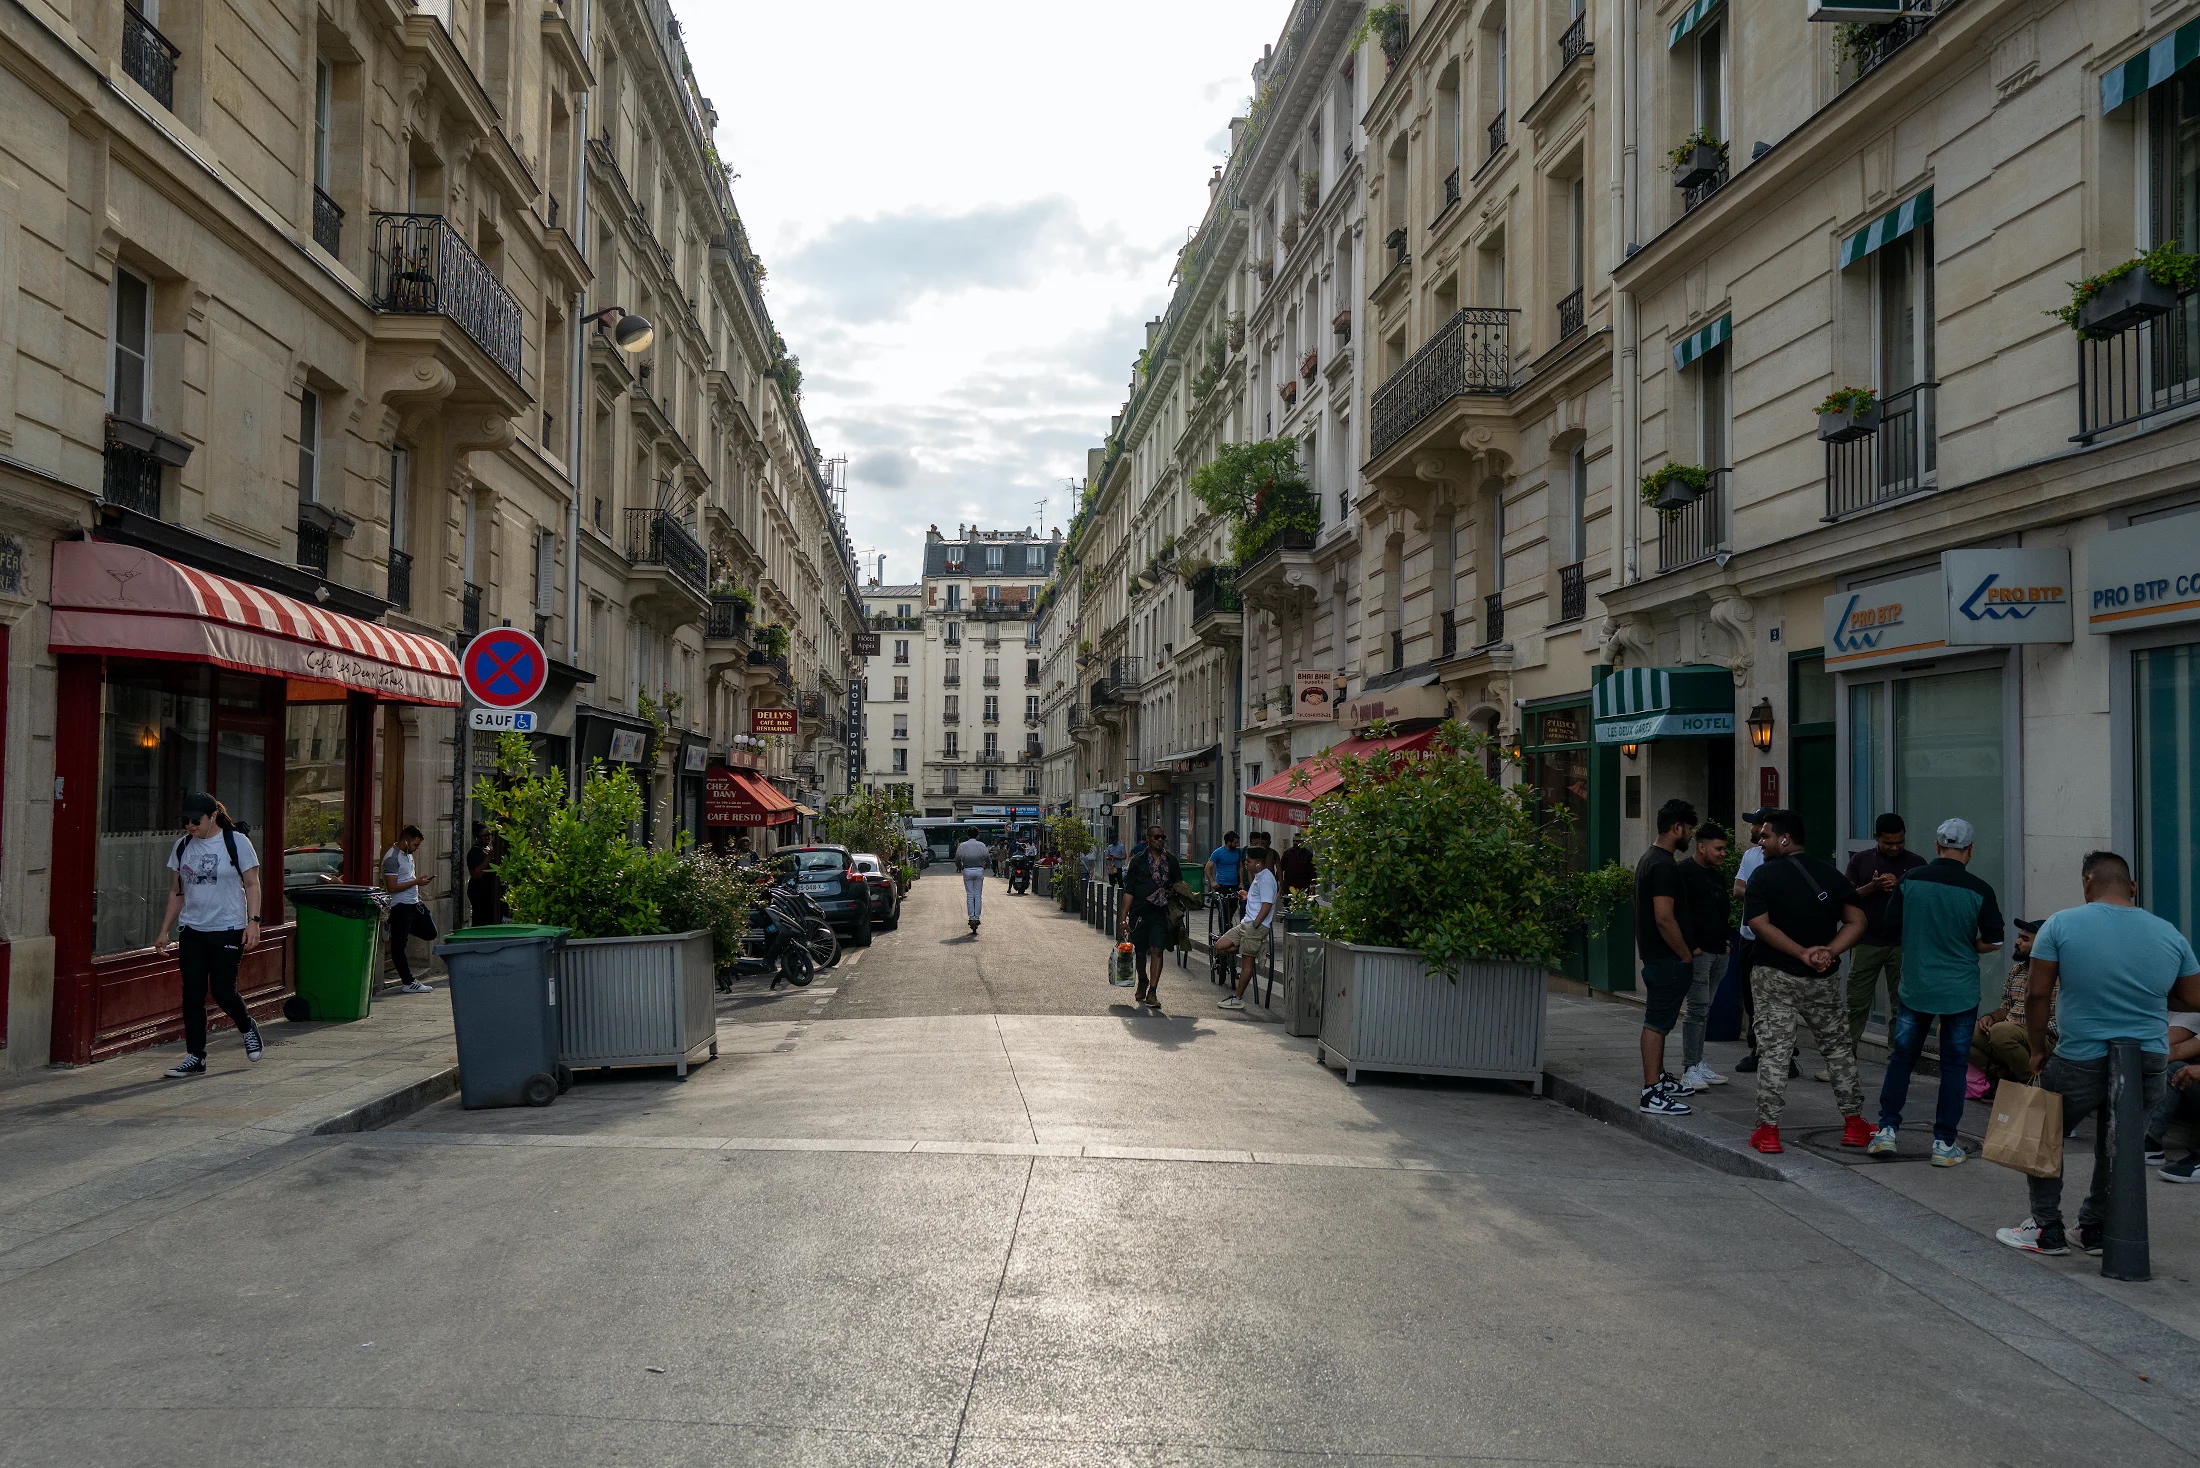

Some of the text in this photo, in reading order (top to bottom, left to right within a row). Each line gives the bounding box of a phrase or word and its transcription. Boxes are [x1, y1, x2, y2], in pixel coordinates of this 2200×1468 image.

[1988, 586, 2063, 602] PRO BTP
[2093, 586, 2129, 609] PRO
[2133, 579, 2169, 603] BTP
[1851, 603, 1902, 629] PRO BTP
[306, 650, 332, 673] Café
[850, 683, 859, 725] HOTEL
[475, 714, 512, 726] SAUF
[757, 711, 792, 719] DELLY'S
[1607, 720, 1653, 738] LES DEUX GARES
[1682, 718, 1731, 729] HOTEL
[706, 782, 730, 790] CHEZ
[1767, 774, 1776, 790] H
[713, 790, 736, 798] DANY
[707, 811, 730, 821] CAFÉ
[732, 813, 762, 822] RESTO
